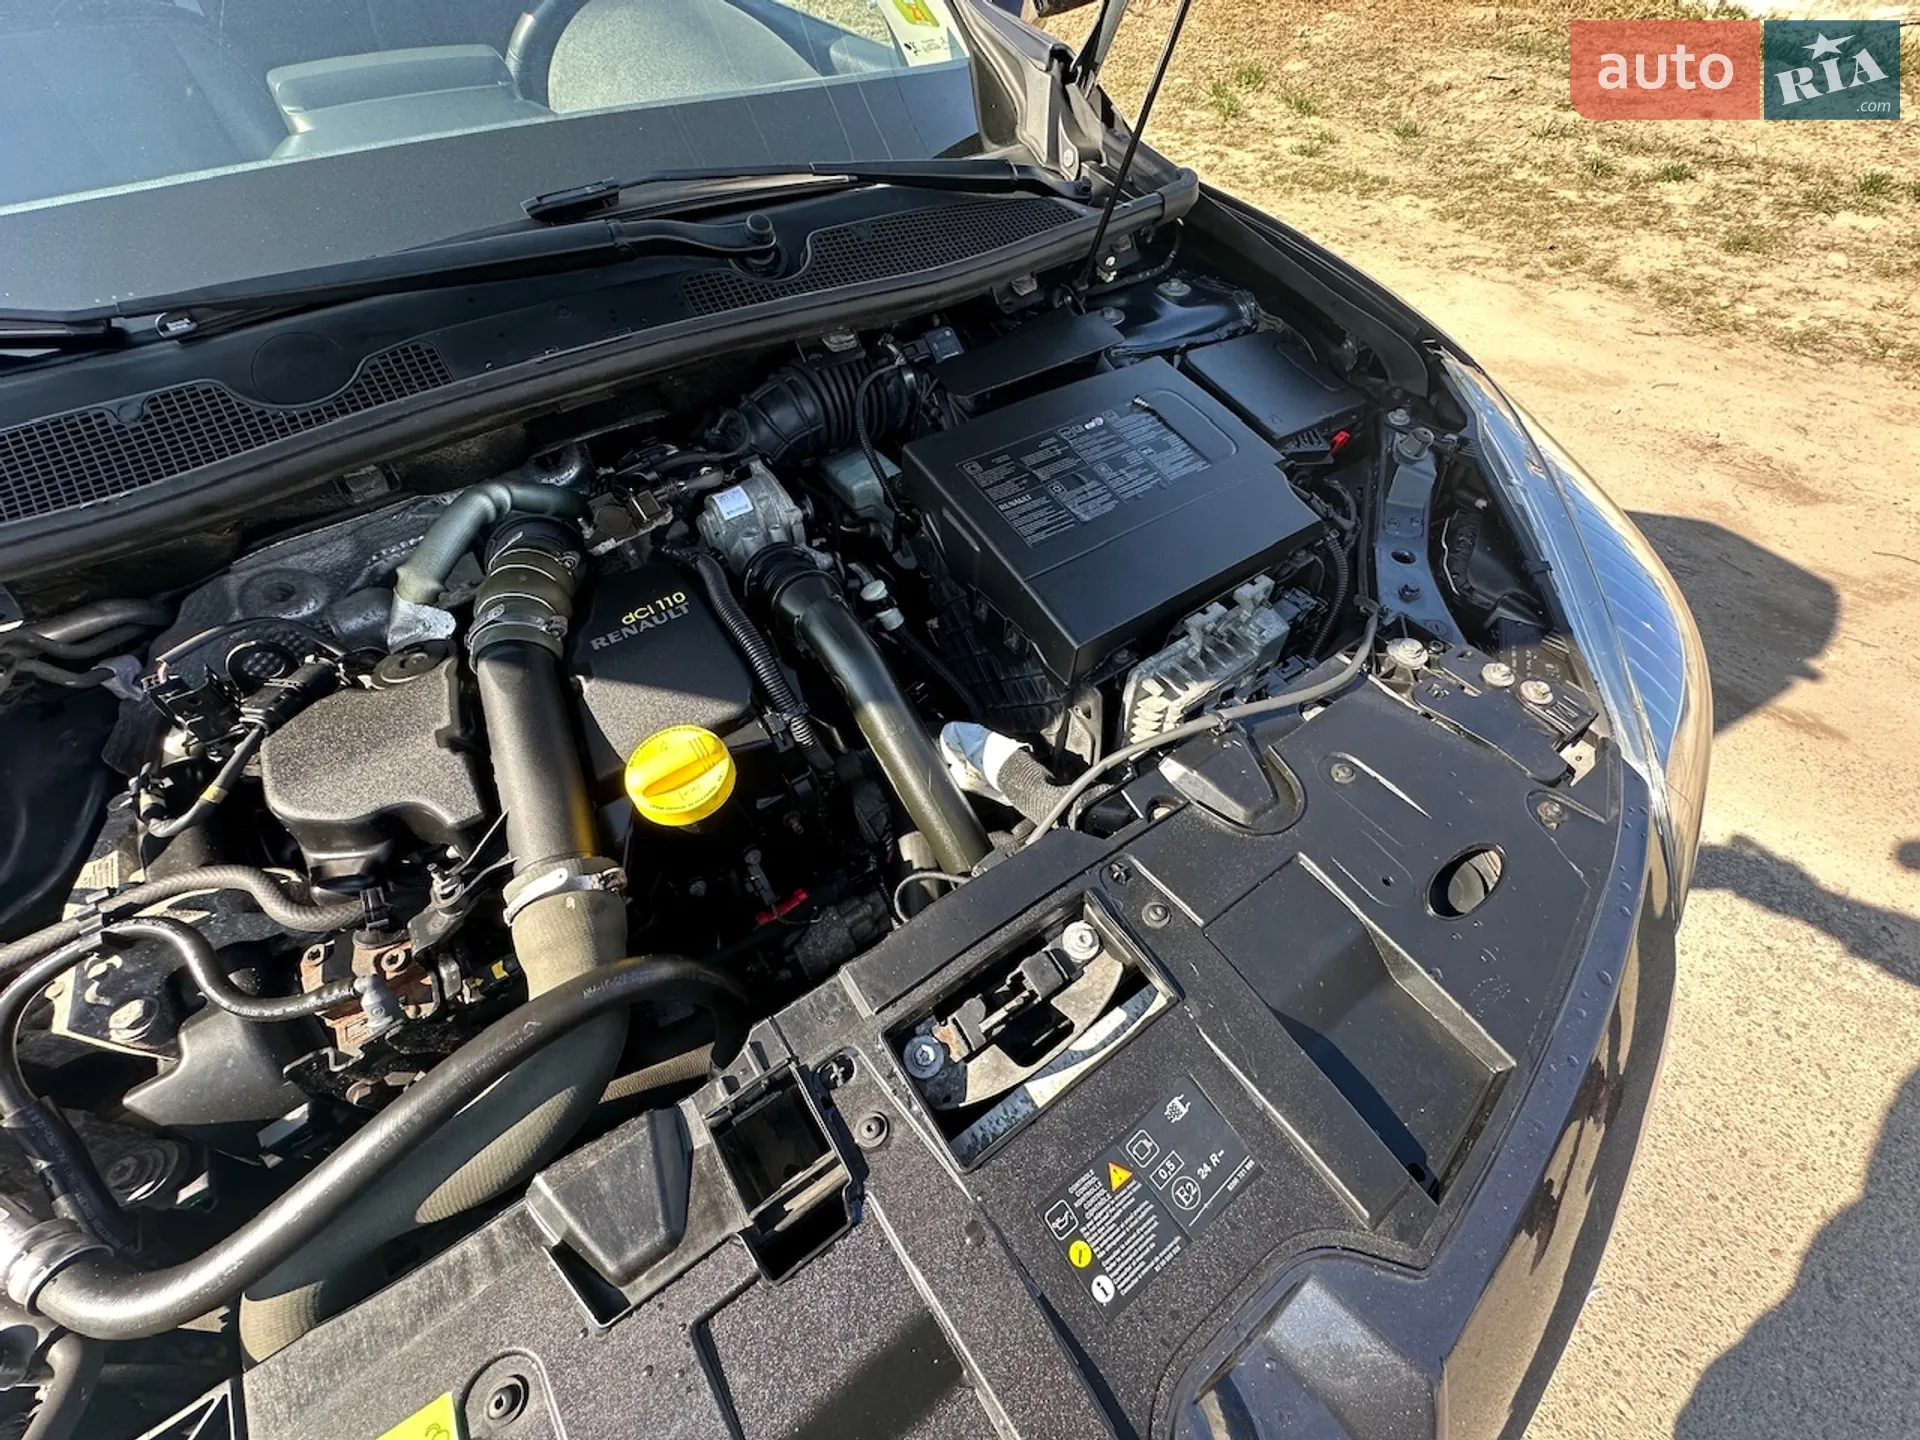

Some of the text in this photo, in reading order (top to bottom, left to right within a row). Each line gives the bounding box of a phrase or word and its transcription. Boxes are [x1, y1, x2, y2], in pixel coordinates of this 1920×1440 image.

[656, 591, 687, 611] 110
[590, 602, 690, 651] RENAULT
[1158, 1160, 1176, 1180] 0,5
[1197, 1163, 1212, 1180] 24
[1175, 1182, 1197, 1207] E2
